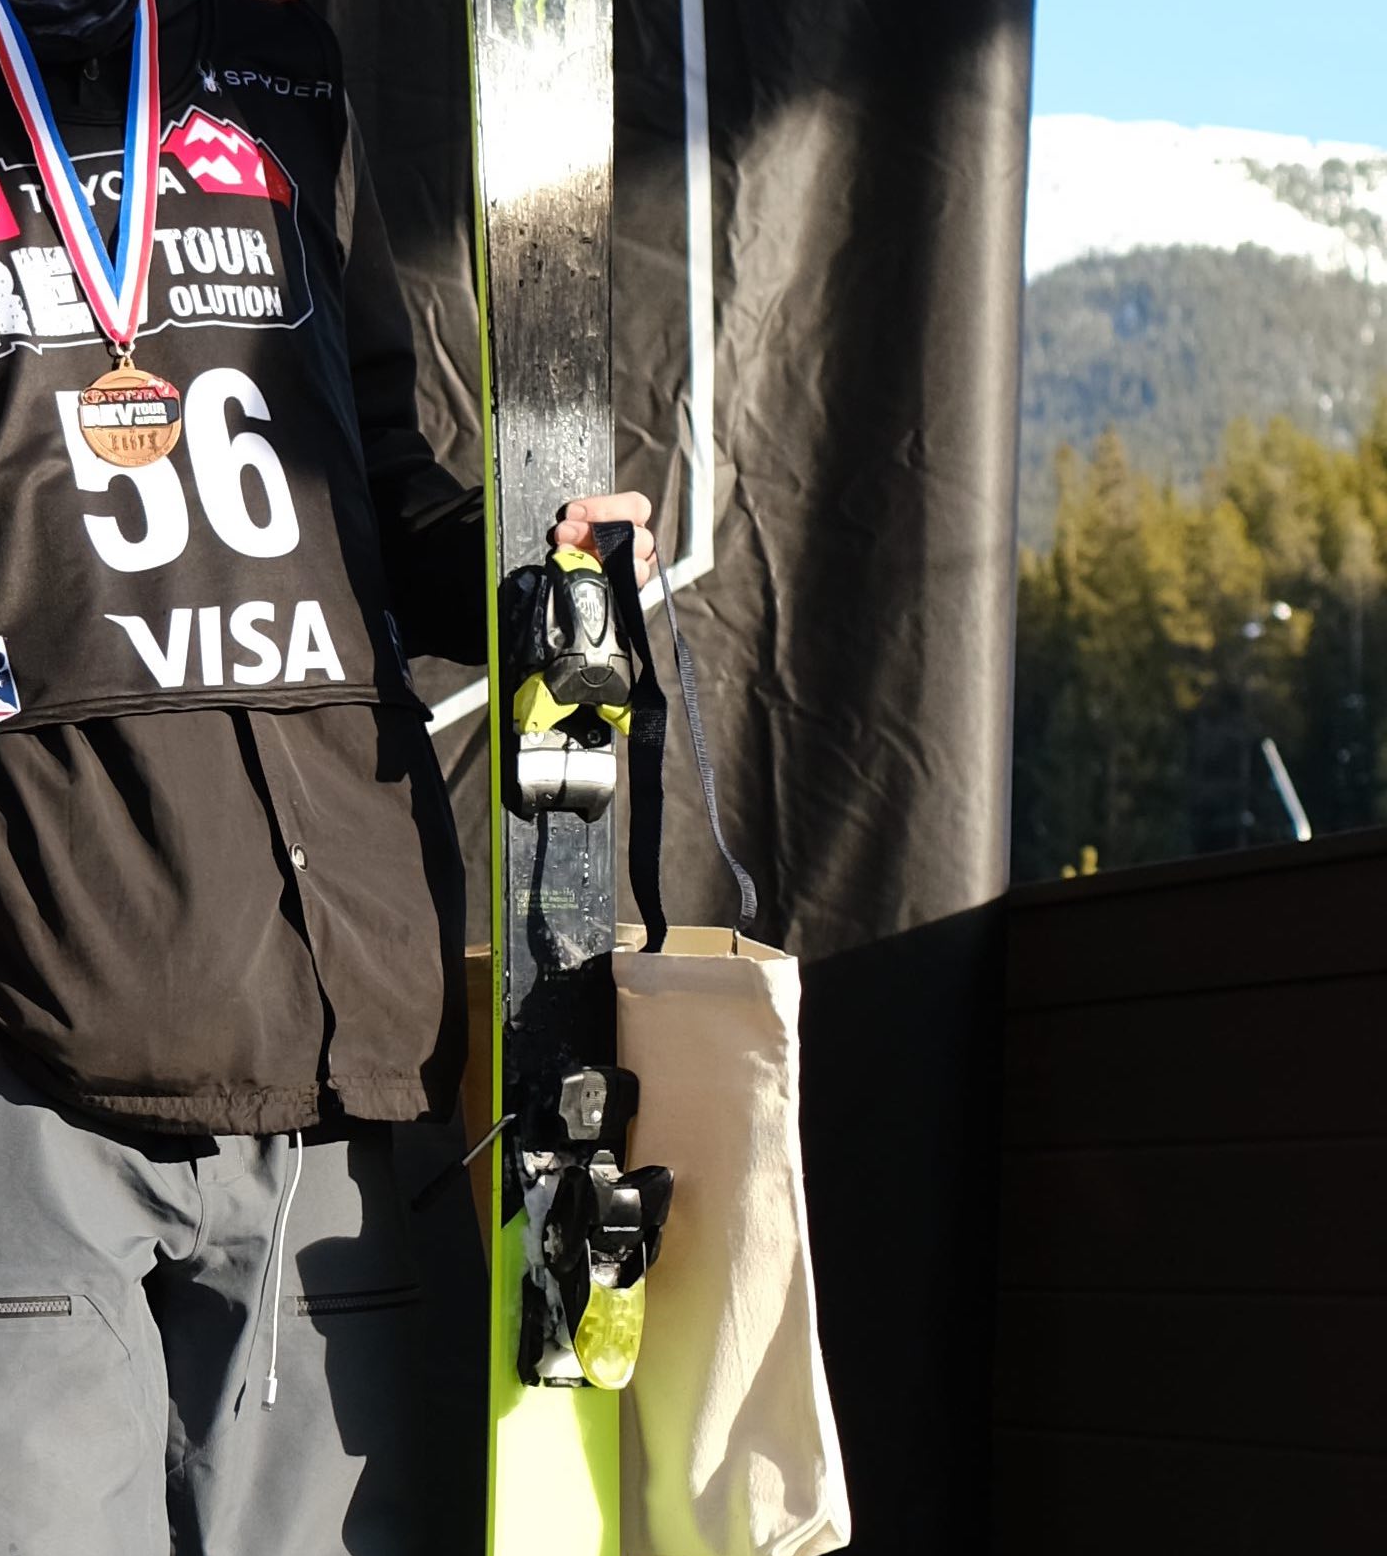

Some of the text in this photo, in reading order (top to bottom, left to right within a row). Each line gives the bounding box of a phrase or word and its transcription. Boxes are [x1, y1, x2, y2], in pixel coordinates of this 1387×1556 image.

[223, 69, 333, 99] SPYDER
[153, 225, 275, 276] TOUR
[168, 284, 284, 318] OLUTION
[134, 402, 167, 415] TOUR
[55, 367, 300, 574] 56
[104, 600, 346, 689] VISA
